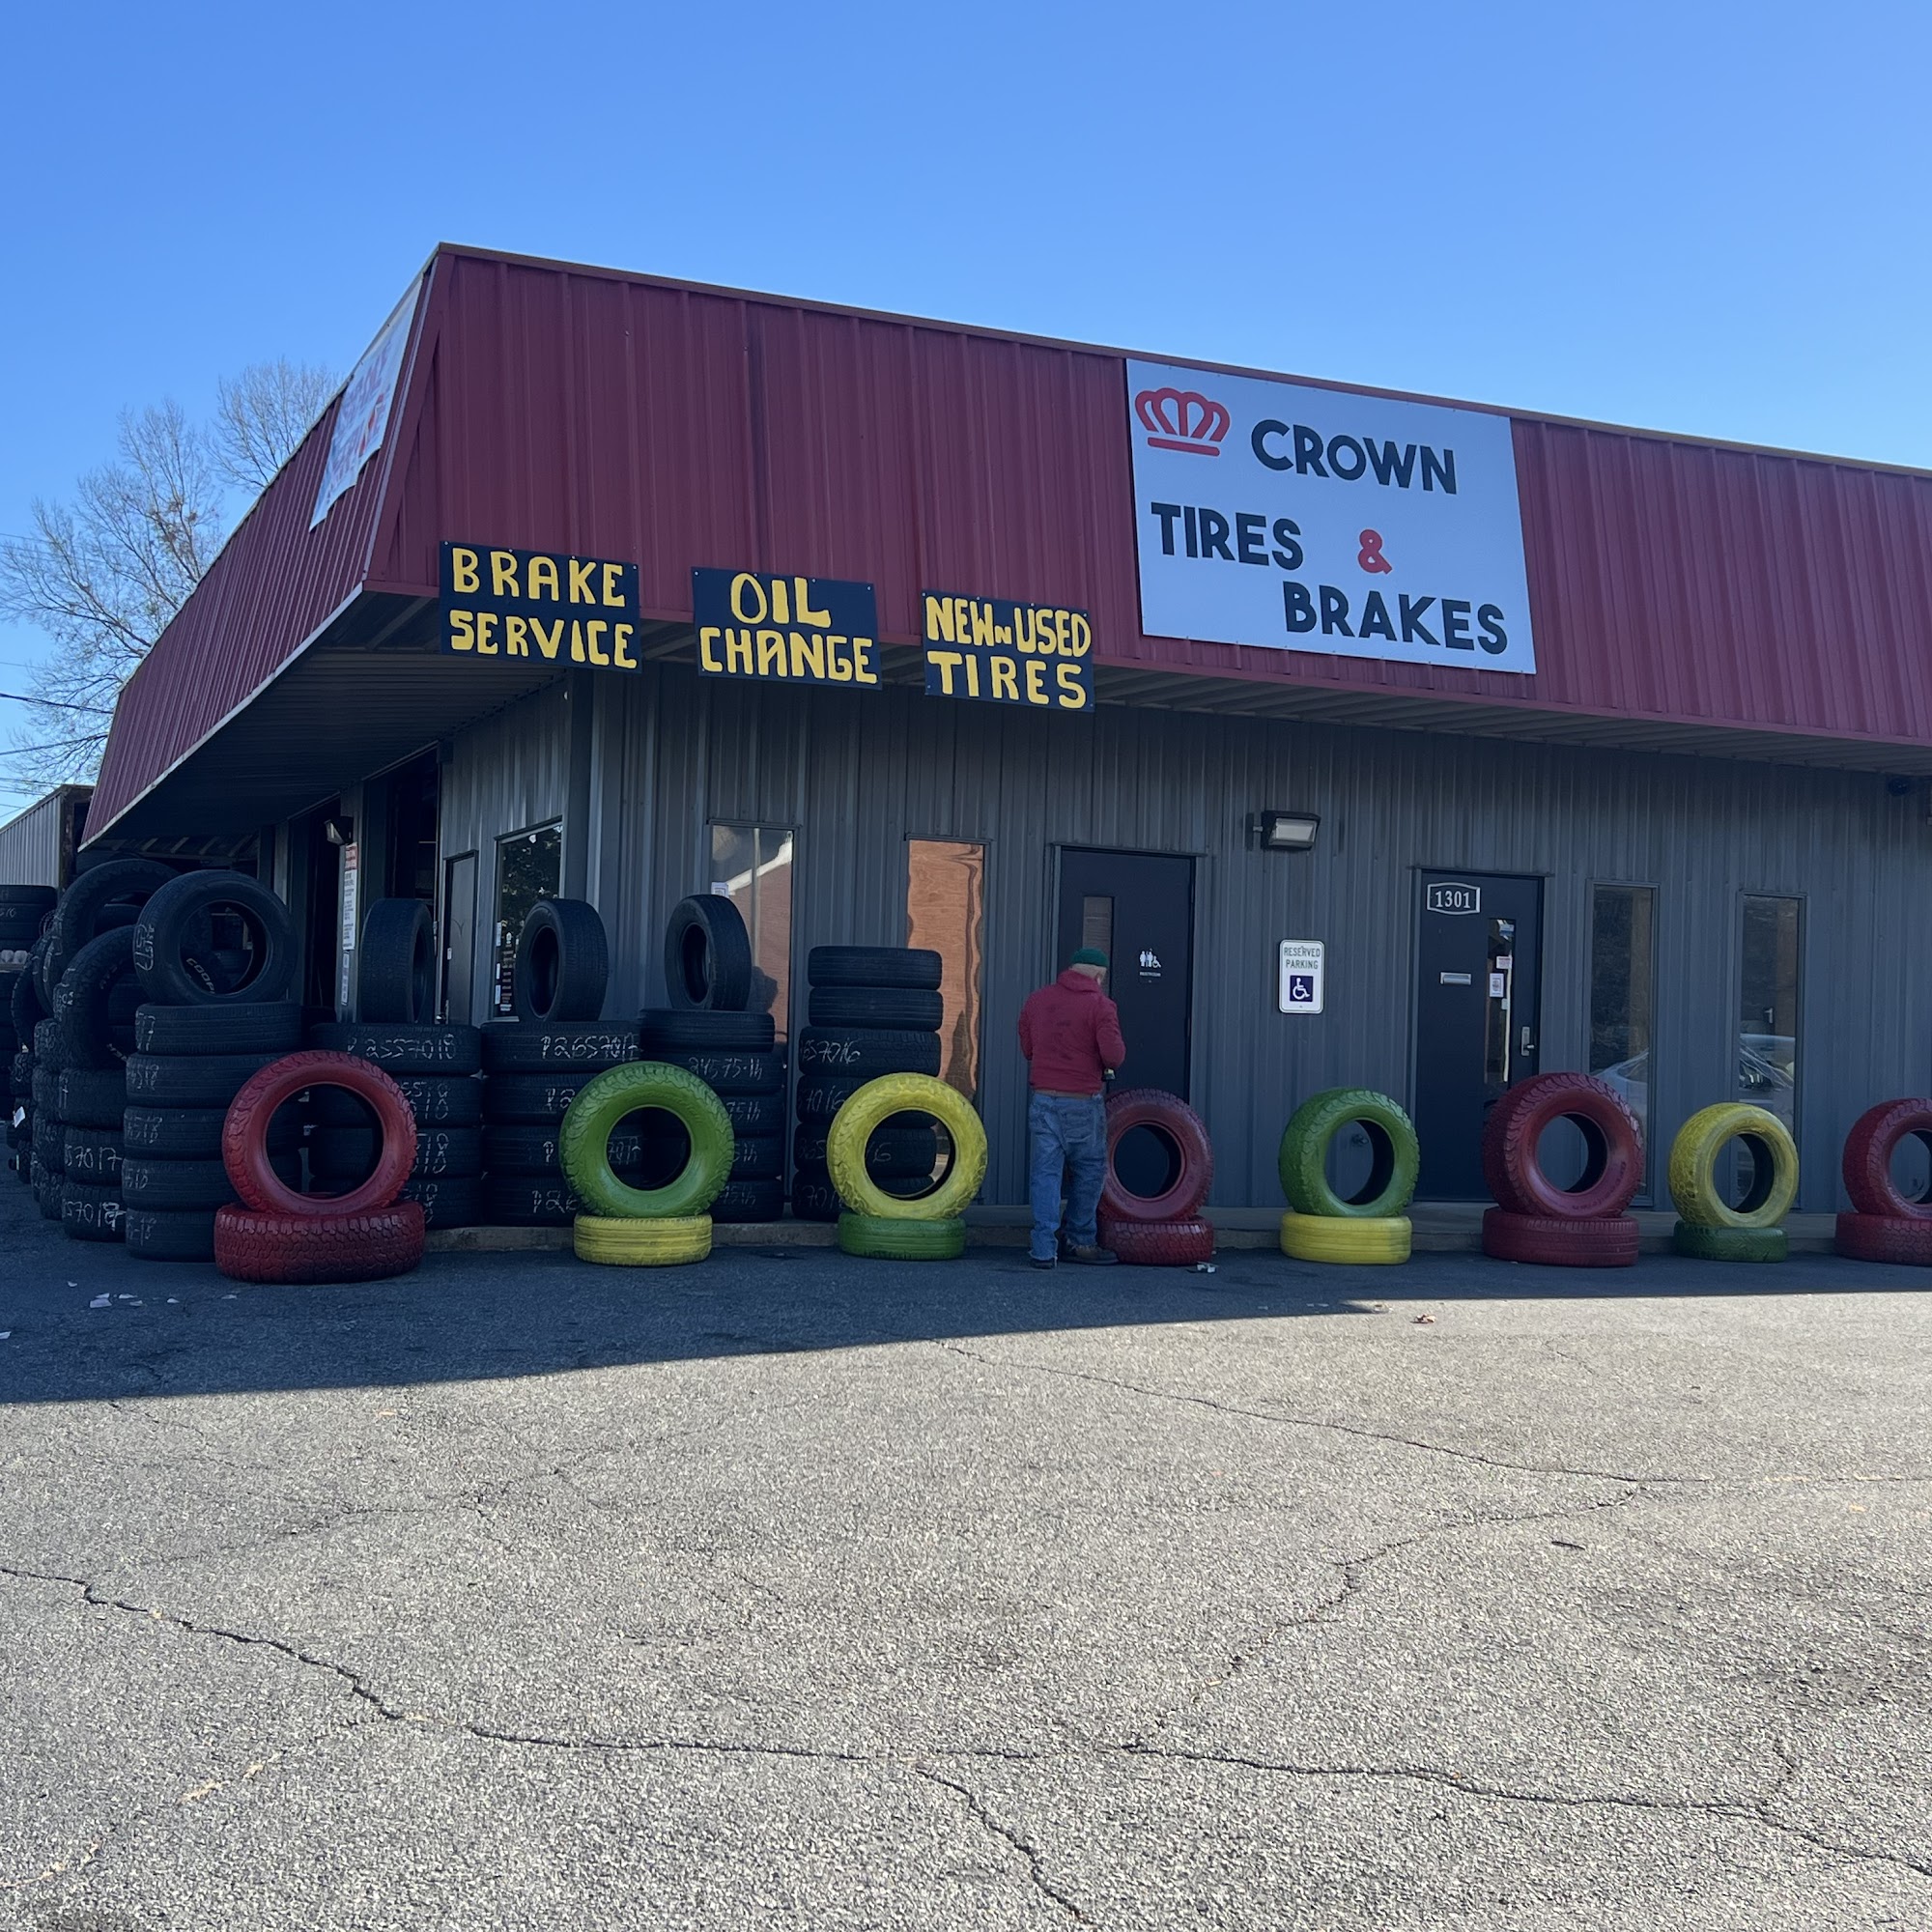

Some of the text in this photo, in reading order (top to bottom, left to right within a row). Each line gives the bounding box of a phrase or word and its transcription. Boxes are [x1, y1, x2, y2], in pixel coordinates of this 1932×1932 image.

[1251, 419, 1457, 495] CROWN
[1151, 501, 1392, 575] TIRES &
[452, 547, 626, 607] BRAKE
[730, 573, 832, 628] OIL
[449, 610, 638, 668] SERVICE
[1283, 581, 1508, 655] BRAKES
[699, 626, 879, 684] CHANGE
[927, 650, 1086, 709] TIRES
[1435, 891, 1470, 908] 1301
[1284, 947, 1321, 957] RESERVED
[1286, 959, 1318, 969] PARKING
